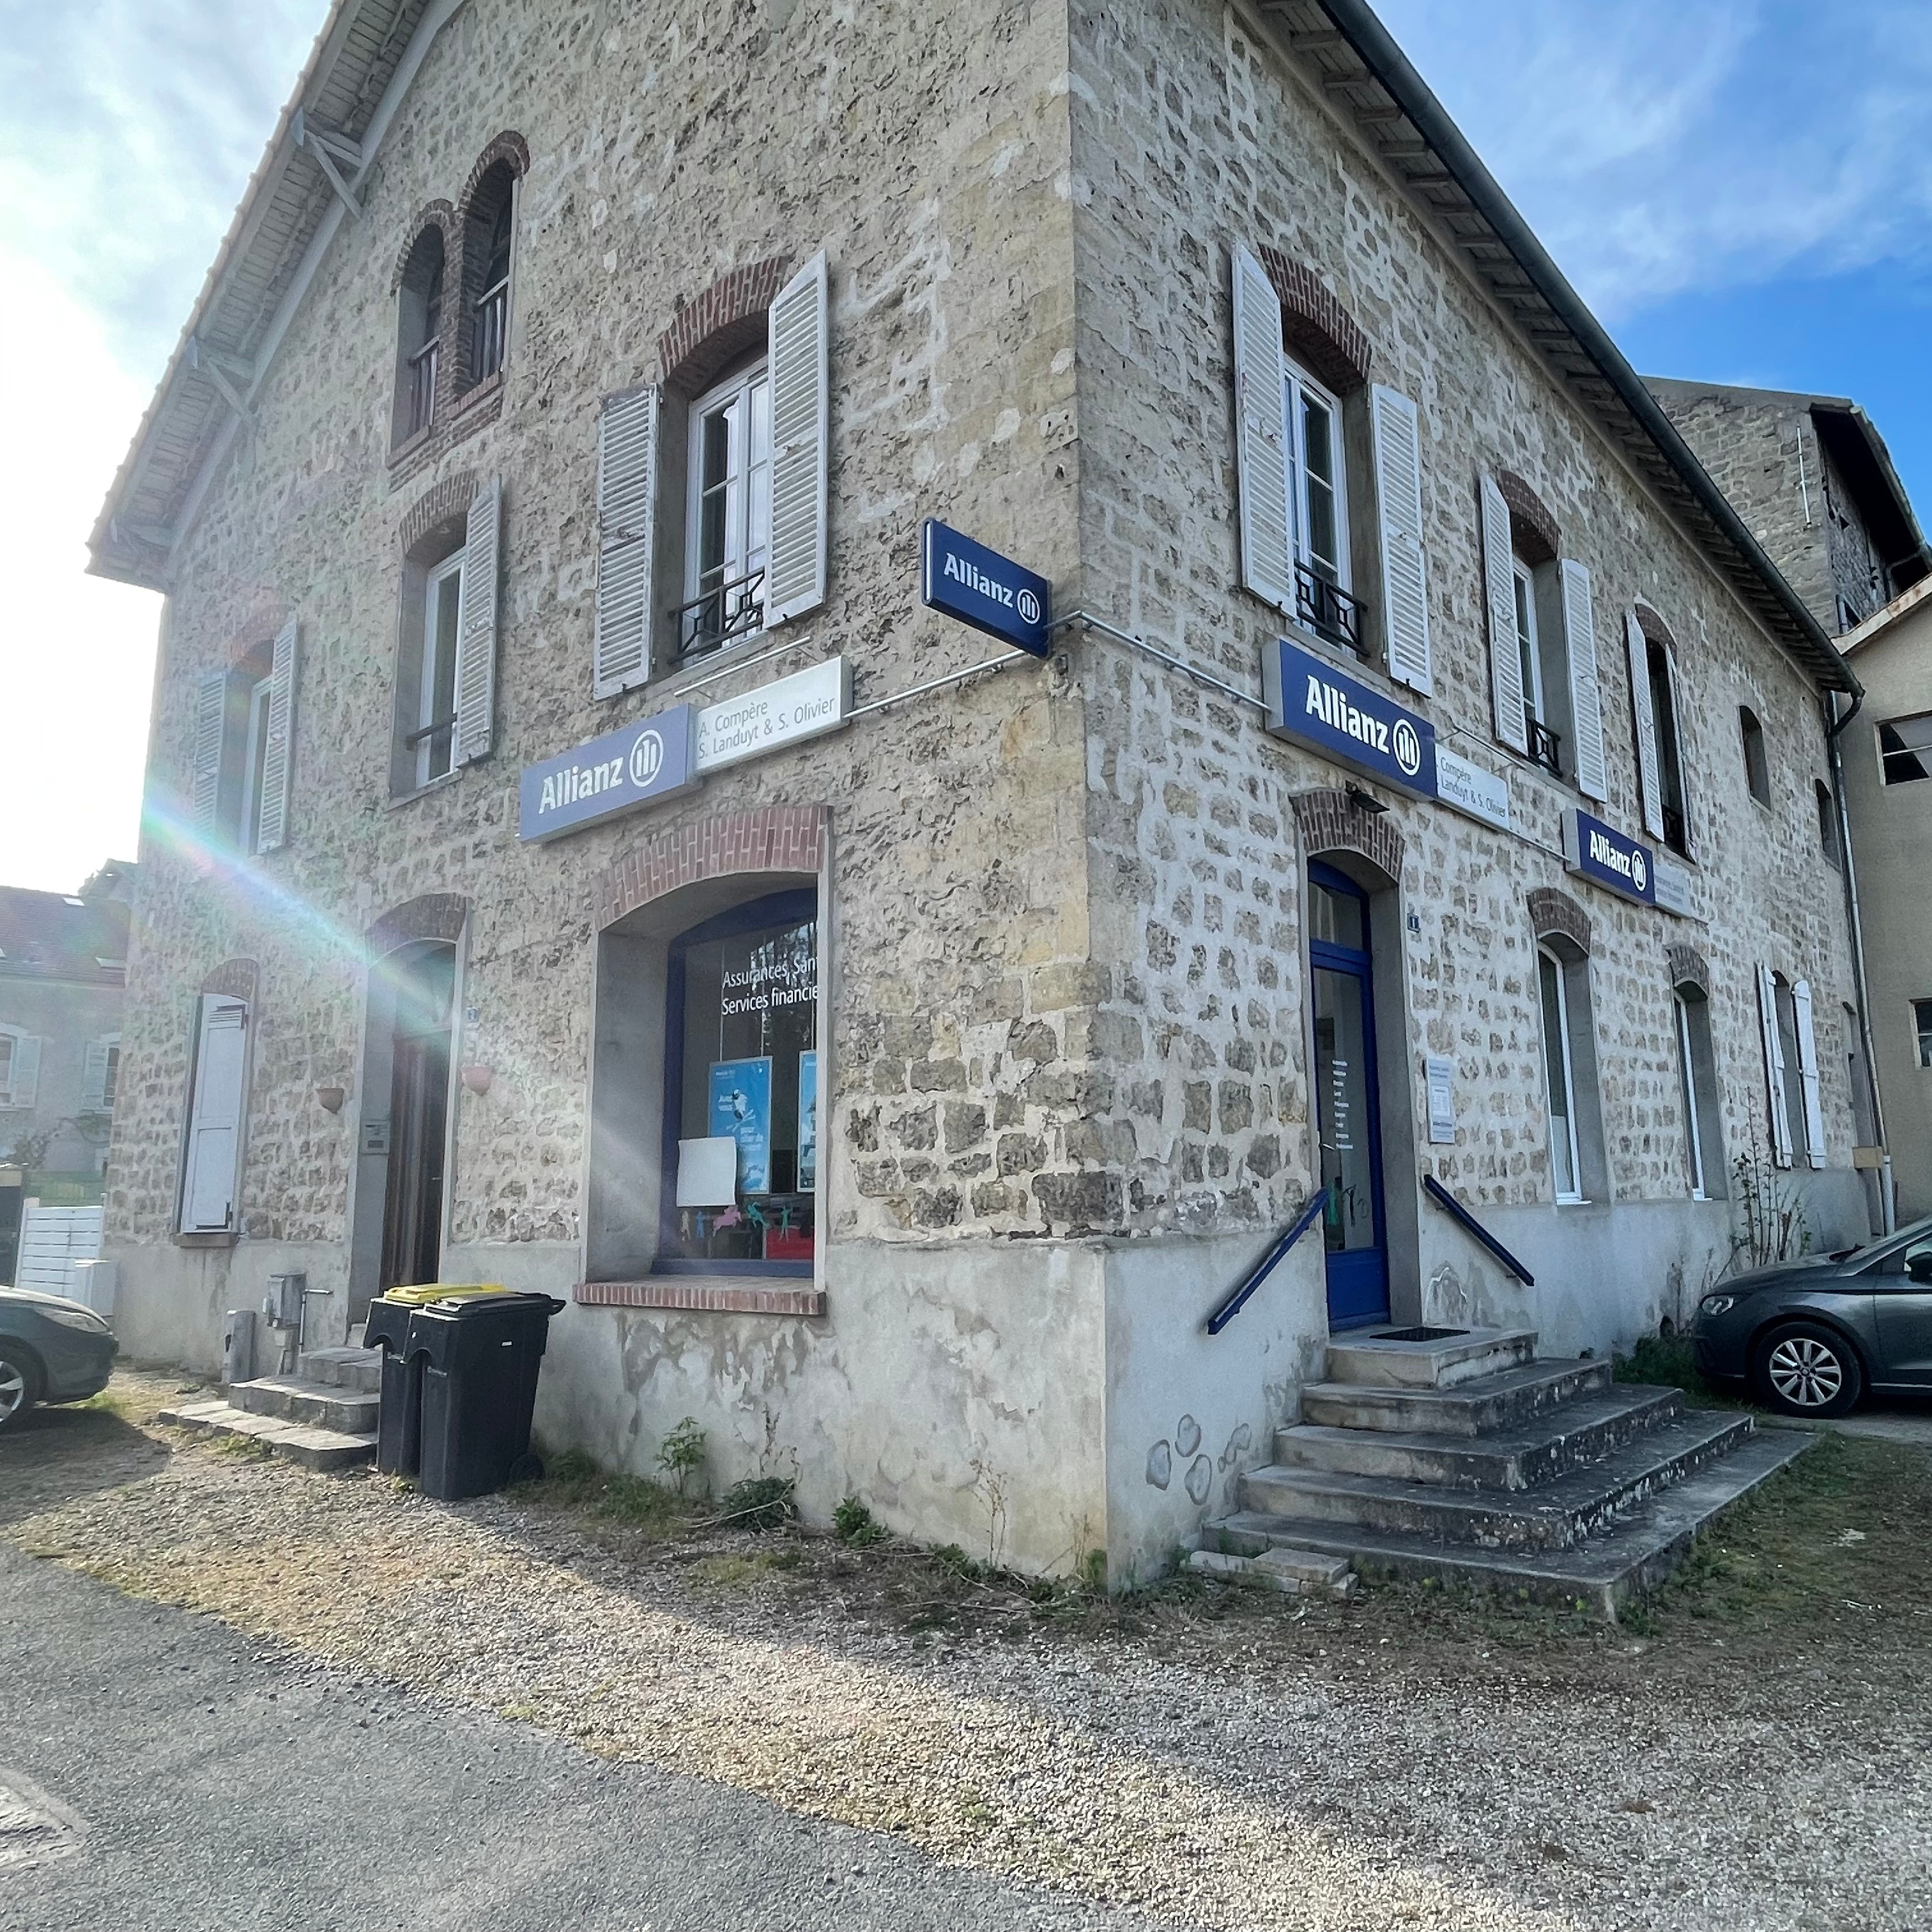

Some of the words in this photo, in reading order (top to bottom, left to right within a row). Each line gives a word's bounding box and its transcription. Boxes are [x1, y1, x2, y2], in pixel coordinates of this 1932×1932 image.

[944, 553, 1013, 608] Allianz
[698, 742, 707, 759] S.
[714, 725, 758, 754] Landuyt
[763, 719, 772, 735] &
[778, 713, 788, 730] S.
[794, 698, 835, 724] Olivier
[699, 721, 710, 738] A.
[716, 702, 767, 732] Compère
[1306, 675, 1390, 755] Allianz
[539, 756, 624, 815] Allianz
[1590, 830, 1631, 878] Allianz
[722, 992, 769, 1015] Services
